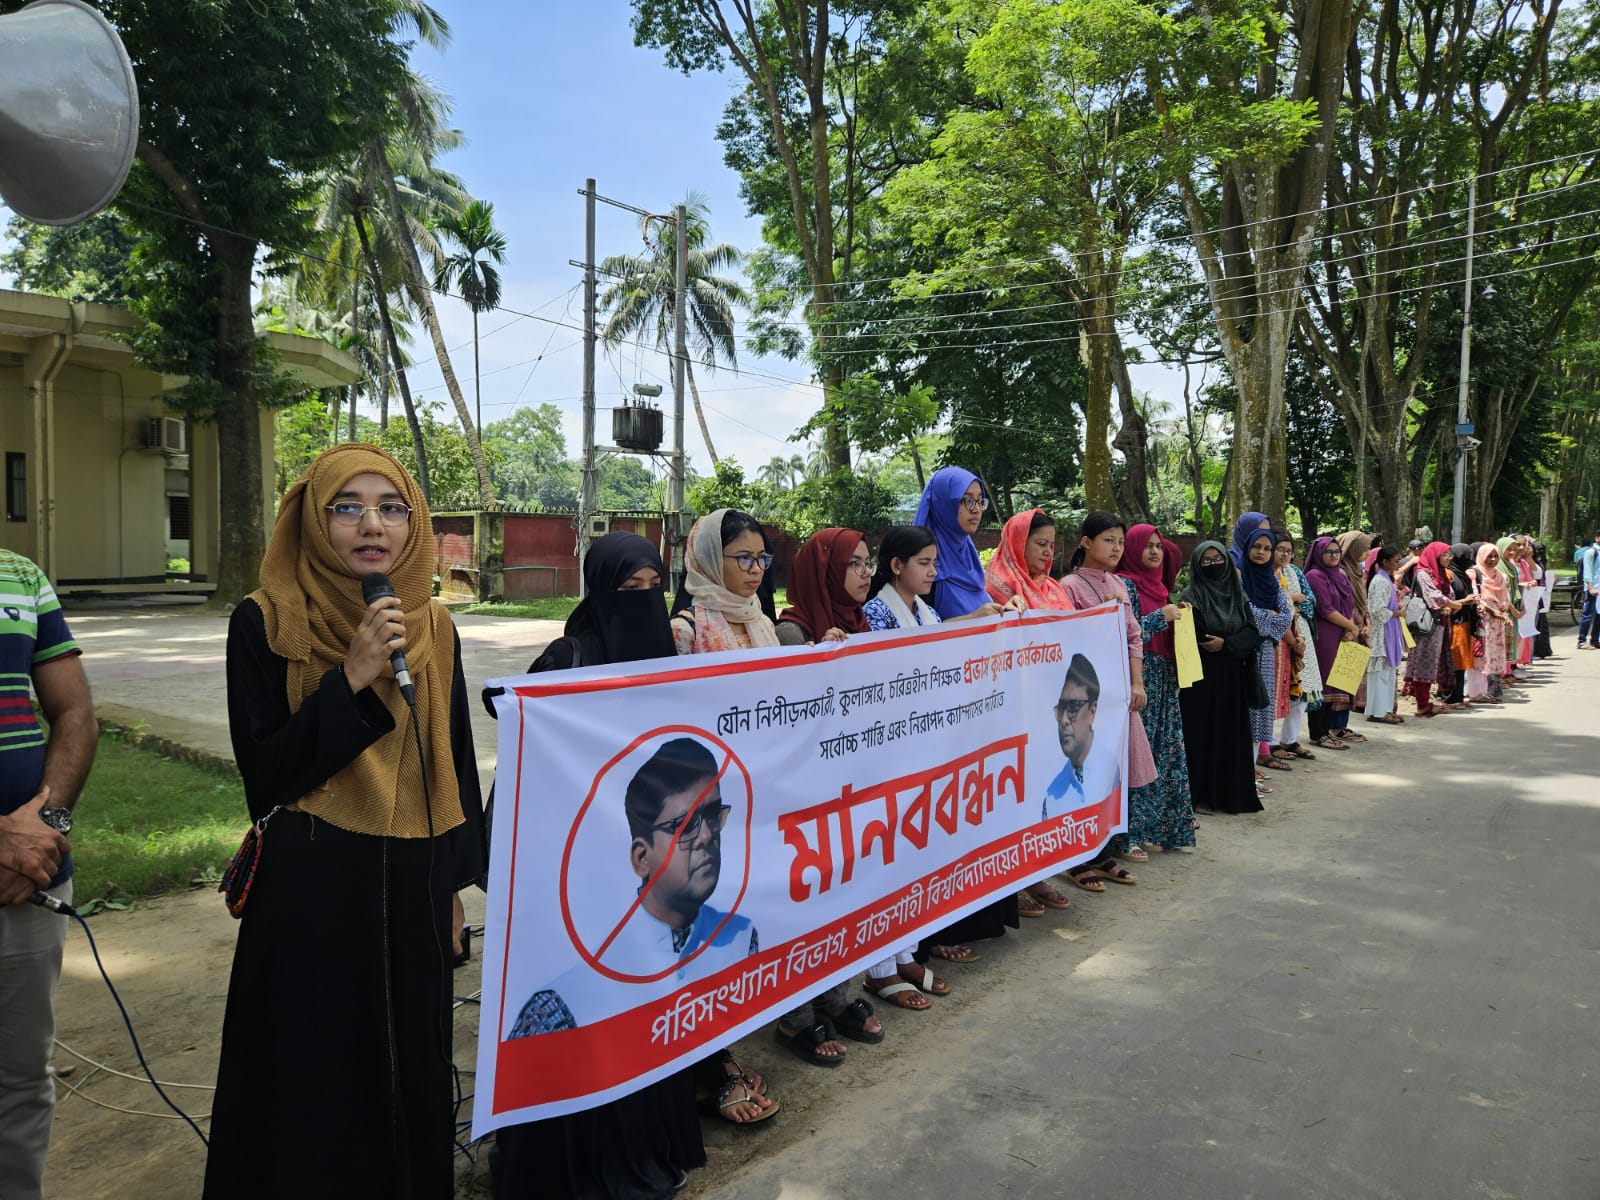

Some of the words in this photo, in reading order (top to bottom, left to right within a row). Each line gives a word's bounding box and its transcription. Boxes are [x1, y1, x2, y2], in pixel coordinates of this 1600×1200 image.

[717, 706, 751, 737] যৌন
[755, 687, 835, 729] নিপীড়নকারী,
[839, 682, 886, 716] কুলাঙ্গার,
[889, 668, 928, 700] চরিত্রহীন
[930, 666, 962, 691] শিক্ষক
[963, 656, 989, 684] প্রভাস
[990, 650, 1014, 682] কুমার
[1016, 641, 1063, 668] কর্মকারের
[820, 731, 858, 759] সর্বোচ্চ
[861, 721, 885, 748] শাস্তি
[887, 719, 906, 741] এবং
[909, 710, 944, 736] নিরাপদ
[777, 733, 1029, 903] মানববন্ধন
[651, 958, 781, 1046] পরিসংখ্যান
[785, 927, 849, 982] বিভাগ,
[854, 882, 924, 948] রাজশাহী
[926, 845, 1020, 911] বিশ্ববিদ্যালয়ের
[1021, 814, 1099, 864] শিক্ষার্থীবৃন্দ
